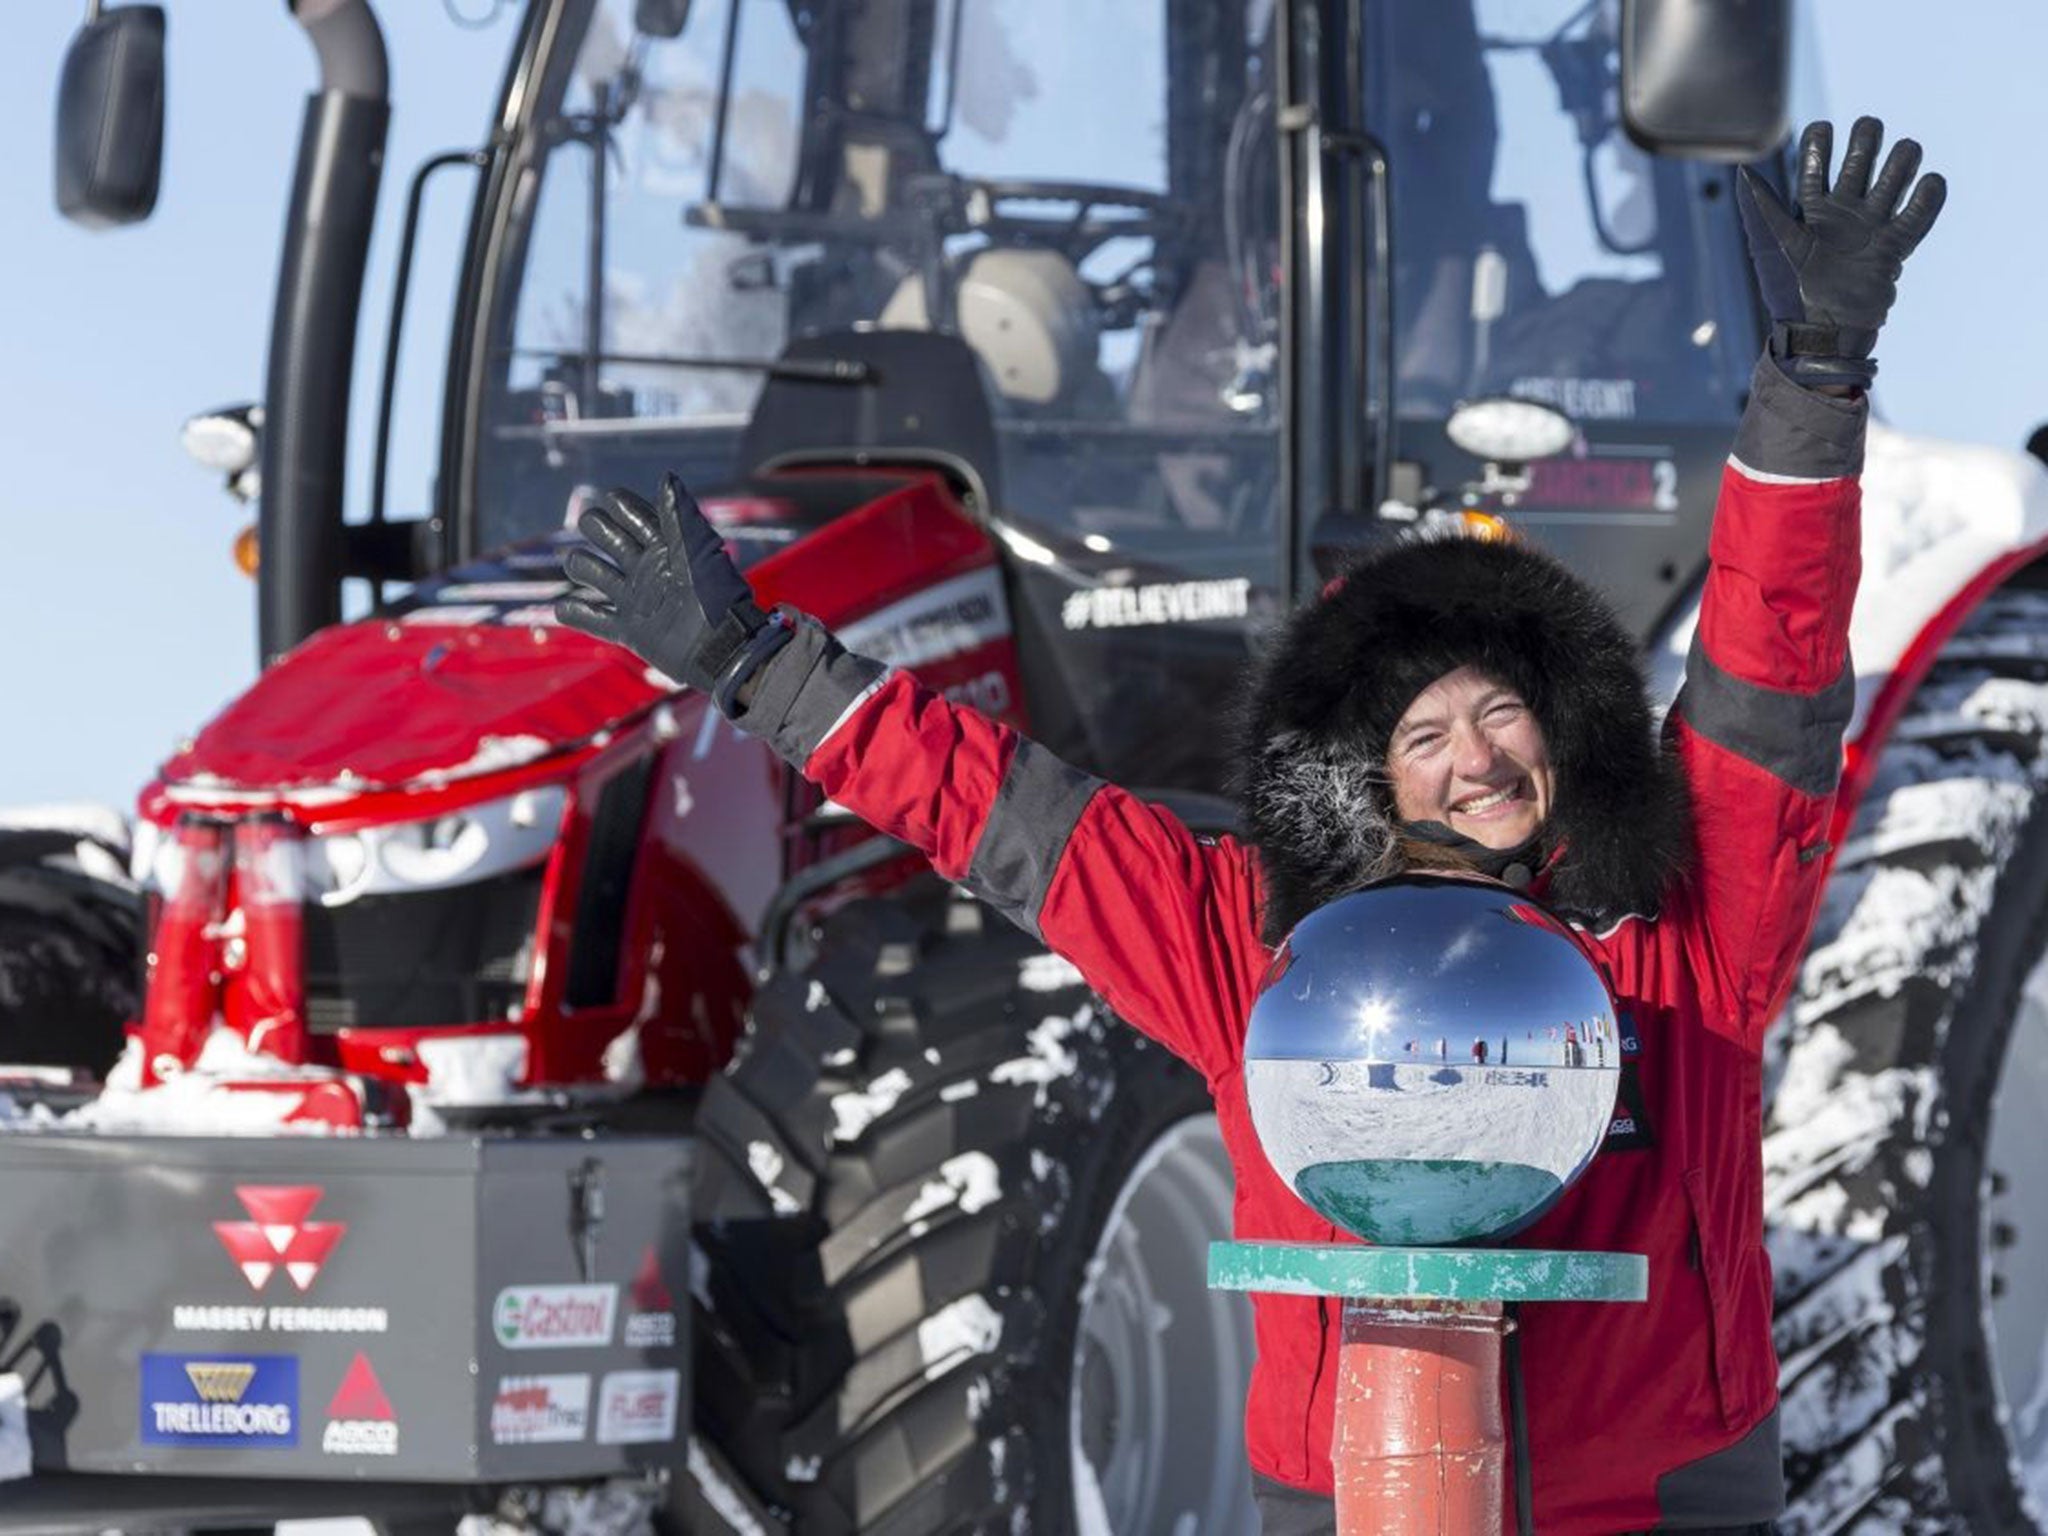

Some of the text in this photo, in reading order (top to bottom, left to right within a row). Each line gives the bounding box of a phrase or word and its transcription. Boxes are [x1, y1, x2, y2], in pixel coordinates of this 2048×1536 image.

[173, 1305, 388, 1332] MASSEY FERGUSON
[152, 1402, 291, 1435] TRELLEBORG
